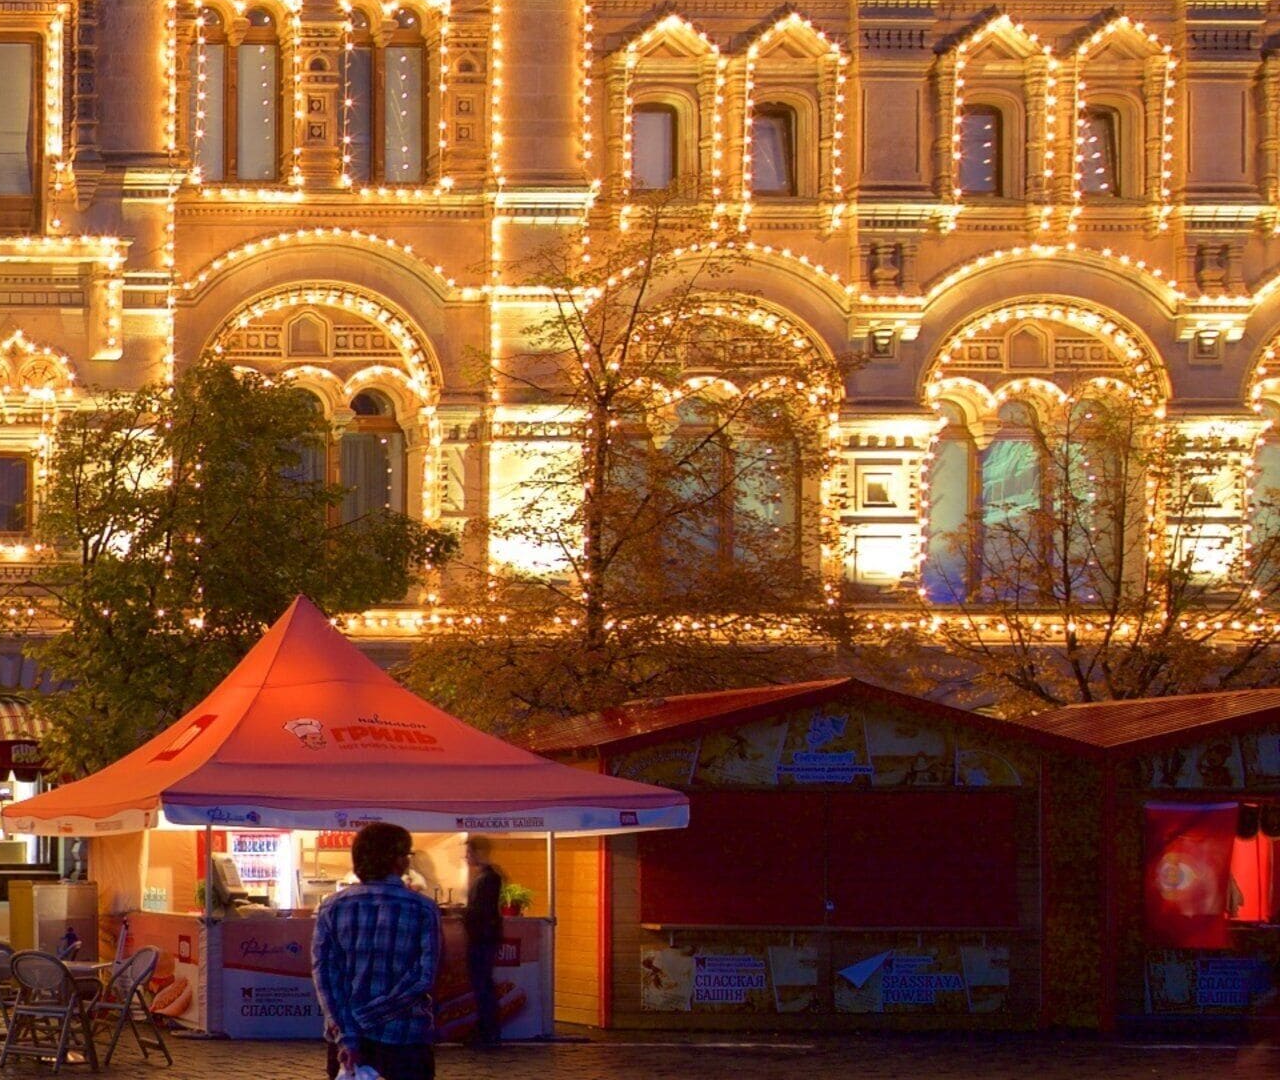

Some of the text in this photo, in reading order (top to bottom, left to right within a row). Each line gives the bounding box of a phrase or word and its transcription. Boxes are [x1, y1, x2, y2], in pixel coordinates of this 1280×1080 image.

[330, 726, 438, 745] ГРИЛЬ
[694, 974, 764, 987] СПАССКАЯ
[882, 975, 963, 989] SPASSKAYA
[695, 989, 742, 1001] БАШНЯ
[882, 989, 934, 1003] TOWER
[240, 1004, 313, 1017] СПАССКАЯ
